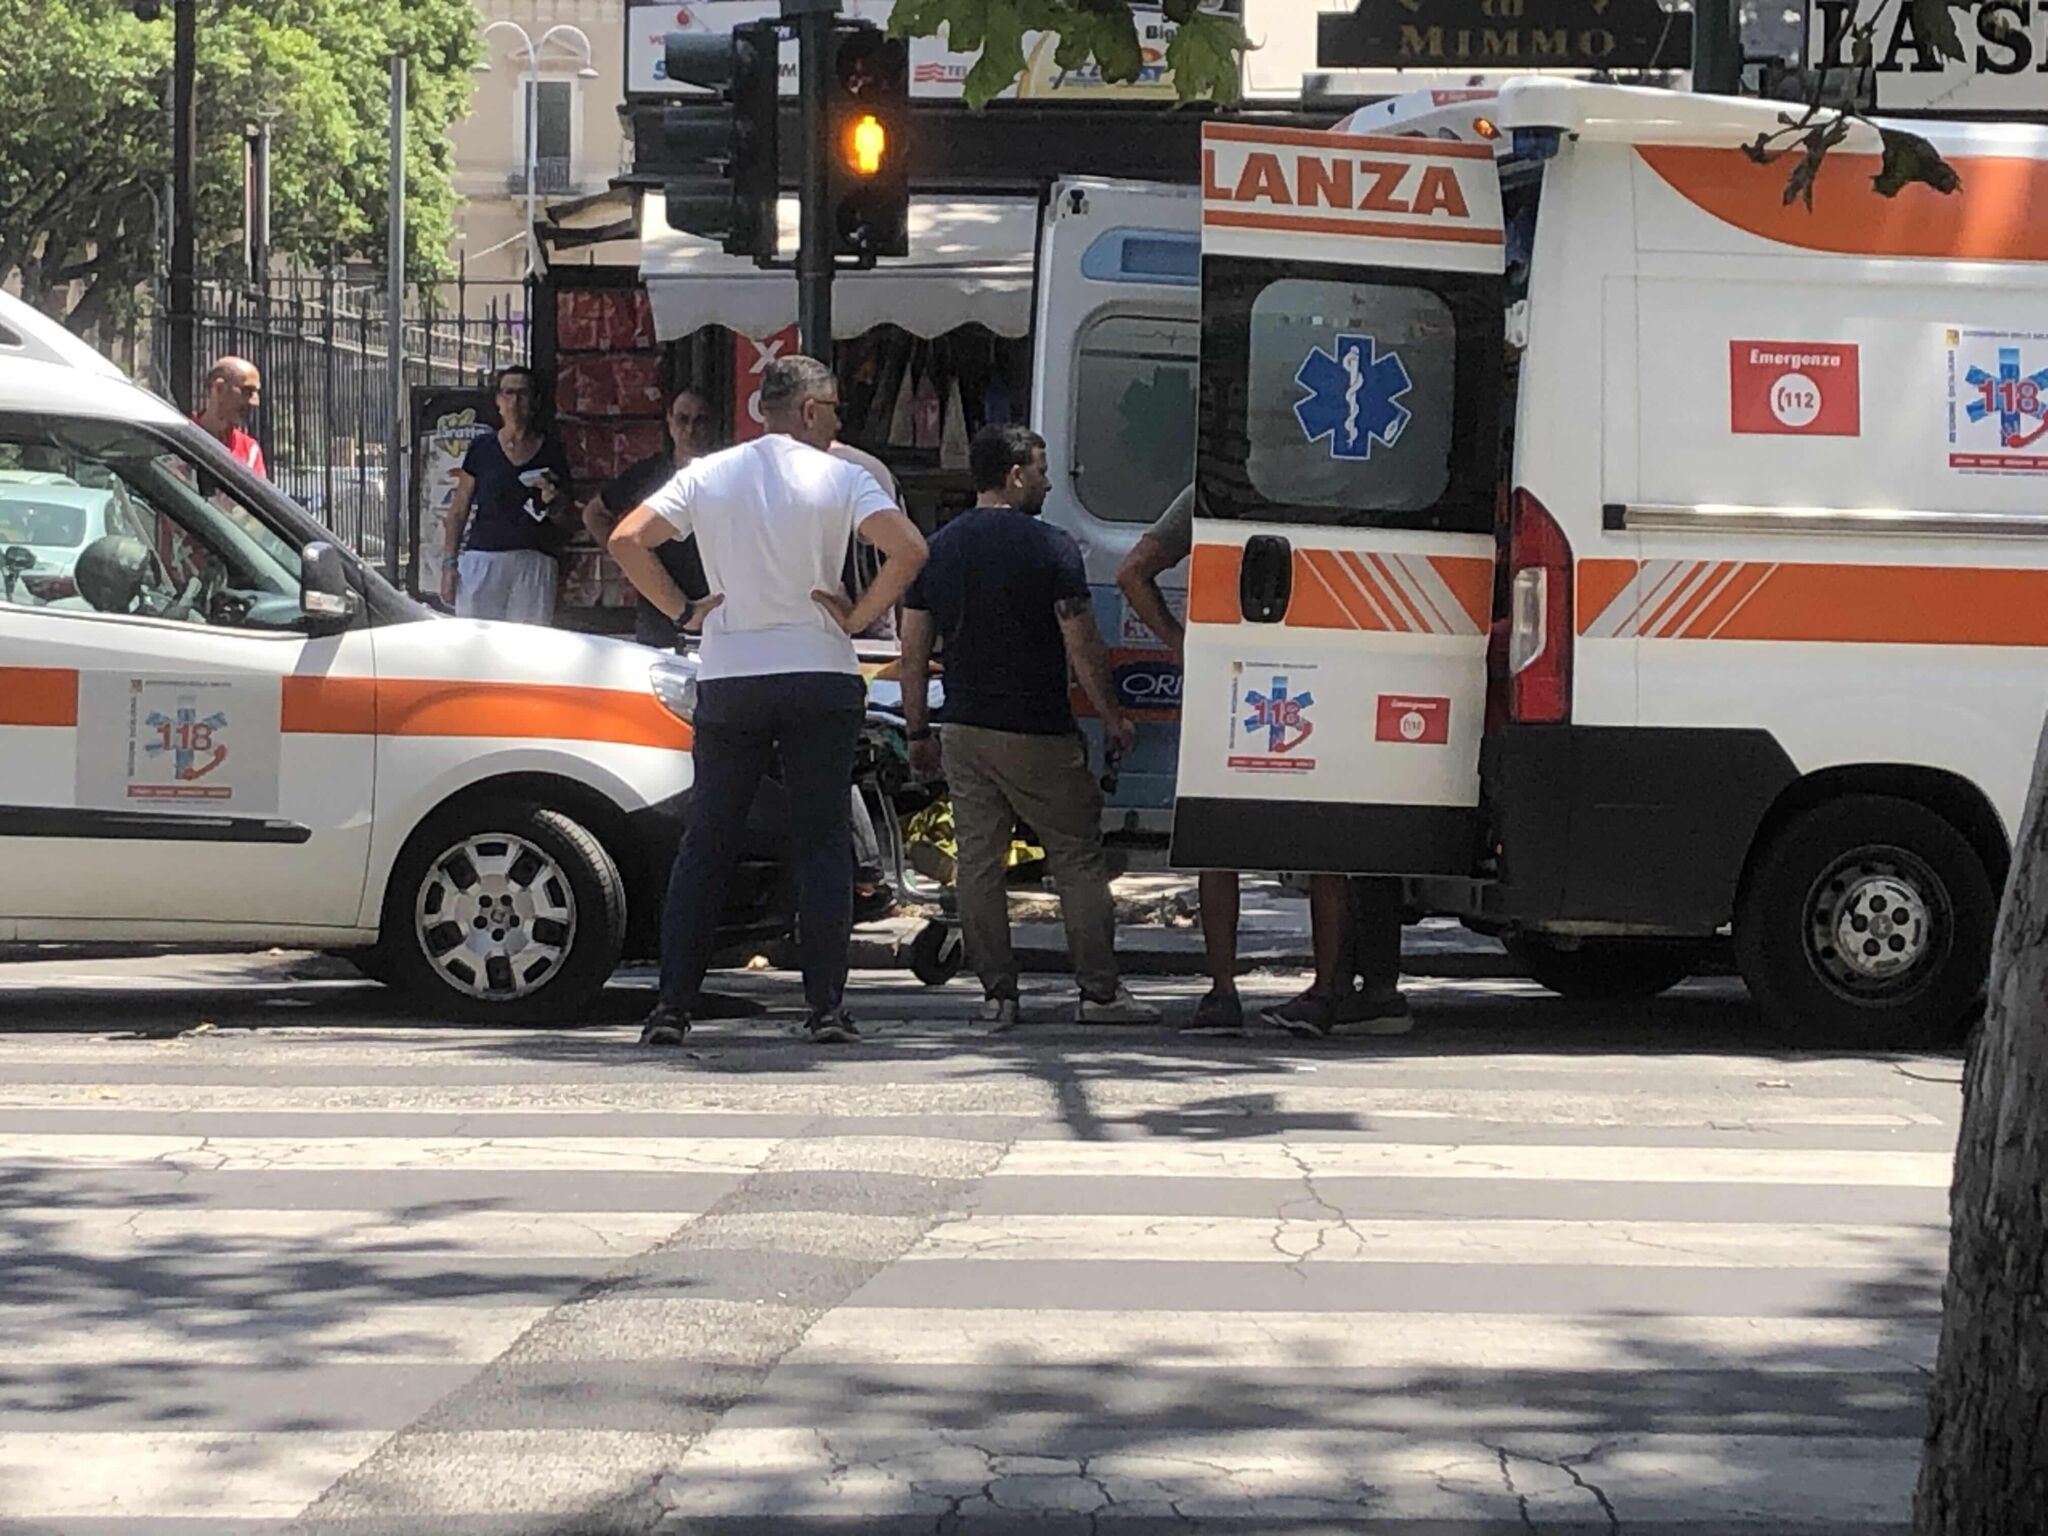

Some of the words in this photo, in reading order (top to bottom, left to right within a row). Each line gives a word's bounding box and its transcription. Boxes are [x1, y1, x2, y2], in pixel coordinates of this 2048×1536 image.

[1400, 25, 1616, 57] MIMMO
[1203, 148, 1471, 219] LANZA
[1750, 348, 1841, 369] Emergenza
[1785, 391, 1815, 409] 112
[1977, 377, 2040, 414] 118
[1254, 698, 1301, 727] 118
[156, 721, 213, 752] 118
